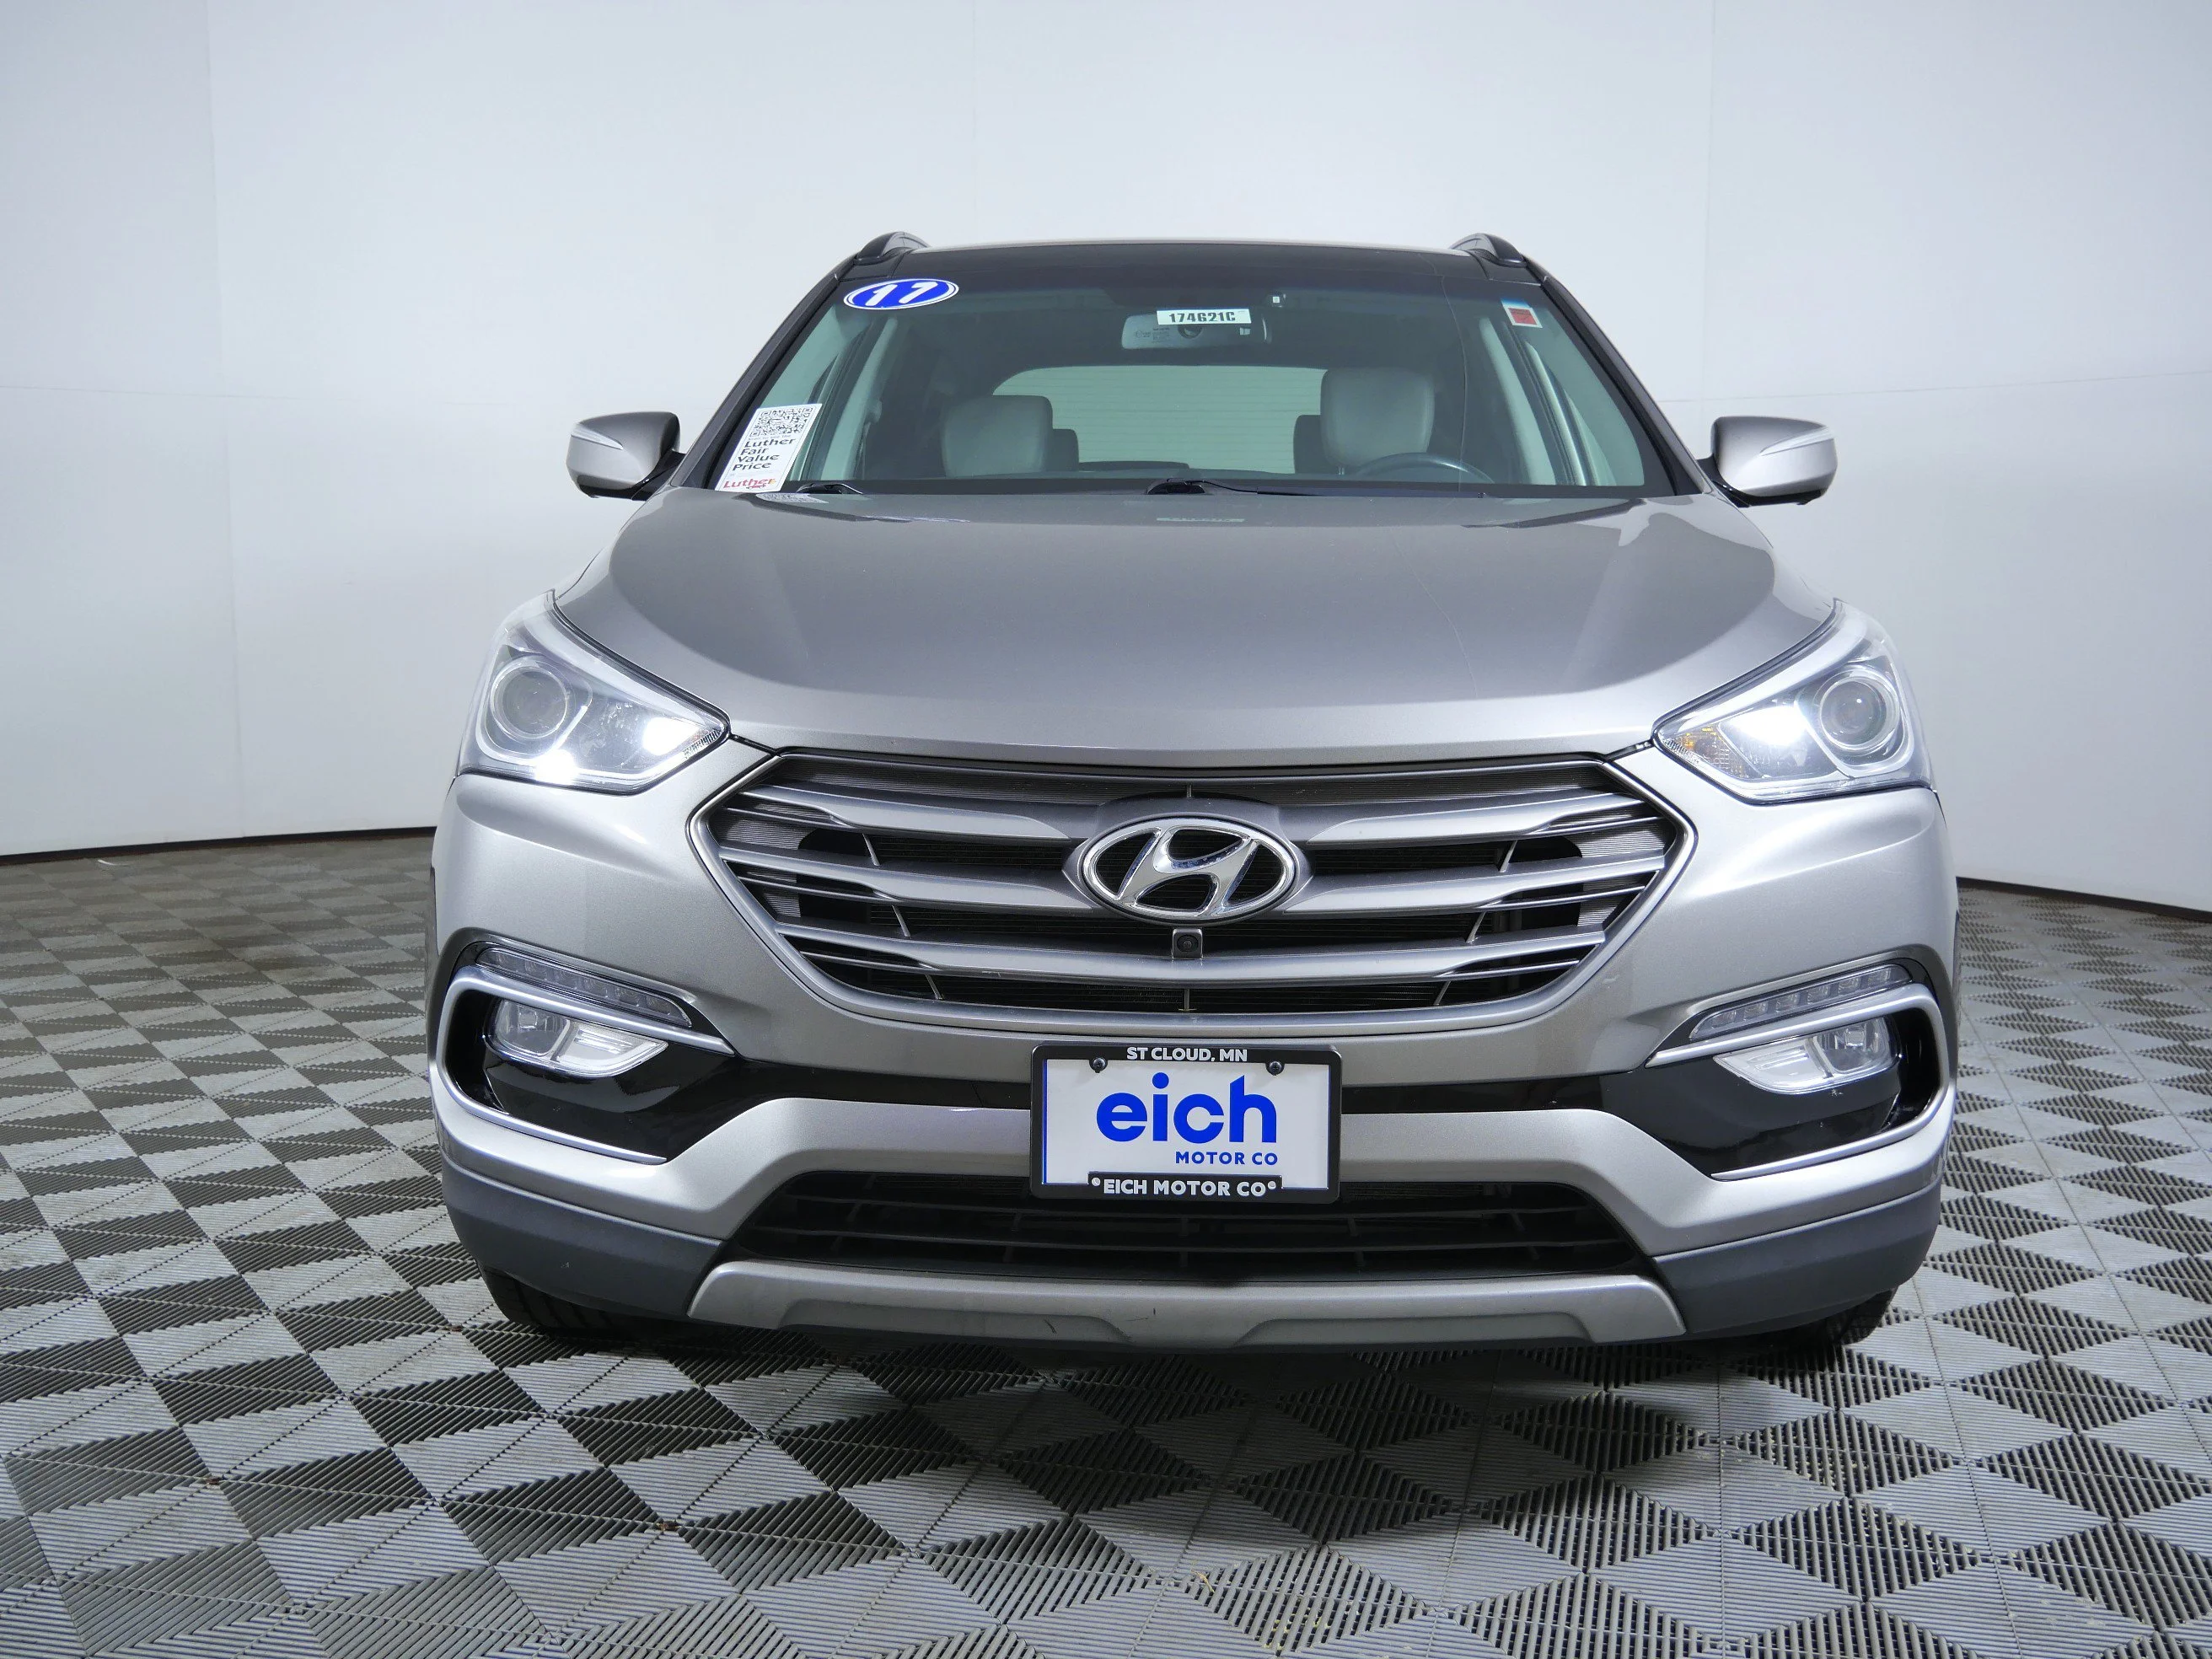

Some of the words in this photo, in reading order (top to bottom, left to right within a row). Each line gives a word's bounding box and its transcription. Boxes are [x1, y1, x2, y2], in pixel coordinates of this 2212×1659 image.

[865, 281, 938, 307] 17
[1169, 311, 1236, 323] 174621C
[744, 438, 796, 448] Luther
[740, 447, 769, 455] Fair
[738, 454, 780, 463] Value
[733, 462, 771, 470] Price
[722, 478, 776, 488] Luther
[1126, 1046, 1148, 1060] ST
[1151, 1047, 1216, 1062] CLOUD,
[1219, 1049, 1248, 1062] MN
[1096, 1071, 1277, 1144] eich
[1175, 1152, 1245, 1165] MOTOR
[1251, 1152, 1278, 1165] CO
[1103, 1178, 1147, 1195] EICH
[1153, 1180, 1231, 1196] MOTOR
[1236, 1182, 1266, 1197] CO
